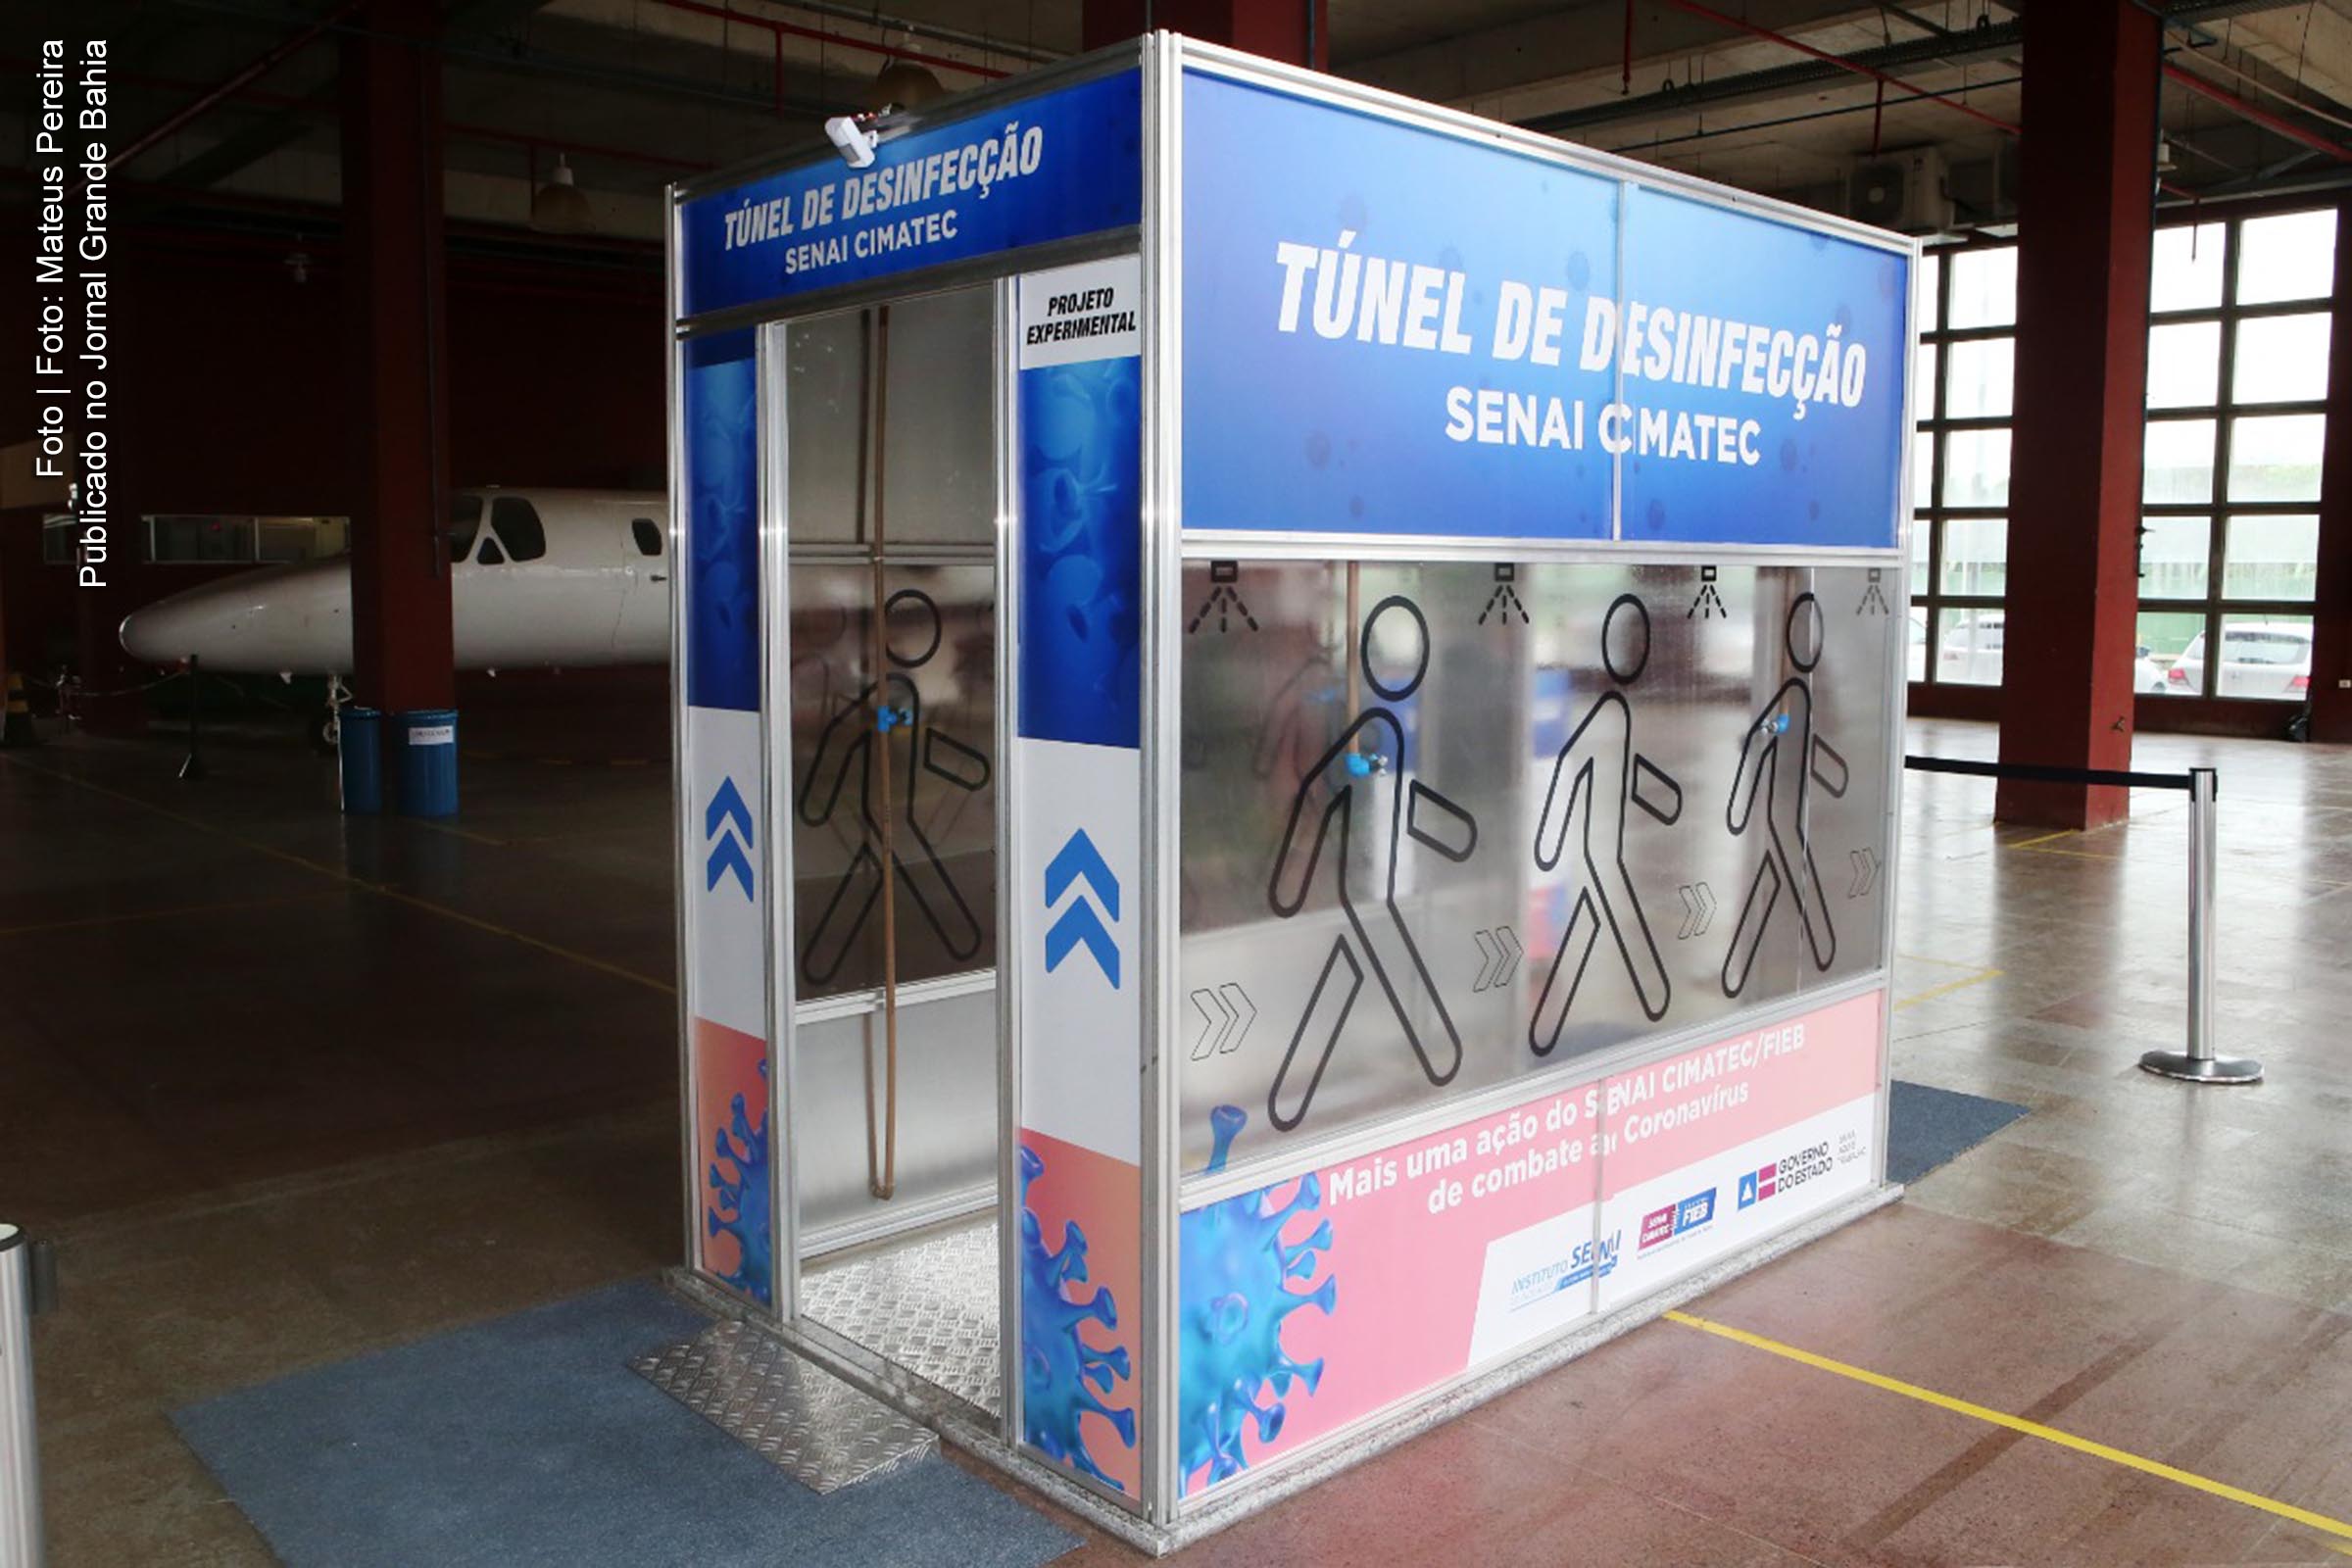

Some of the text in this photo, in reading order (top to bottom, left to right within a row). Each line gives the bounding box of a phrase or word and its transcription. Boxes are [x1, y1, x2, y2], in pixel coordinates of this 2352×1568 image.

[724, 122, 1043, 250] TÚNEL DE DESINFECÇÃO
[784, 209, 958, 274] SENAI CIMATEC
[1026, 311, 1137, 345] EXPERIMENTAL
[1047, 286, 1114, 317] PROJETO
[1276, 229, 1867, 420] TÚNEL DE DESINFECÇÃO
[1445, 384, 1761, 466] SENAI CMATEC
[1329, 1022, 1805, 1206] Mais uma ação do SENAI CIMATEC/FIEB
[1427, 1178, 1463, 1215] de
[1471, 1139, 1583, 1199] combate
[1624, 1081, 1749, 1145] Coronavírus
[1778, 1140, 1830, 1175] GOVERNO
[1794, 1156, 1834, 1186] ESTADO
